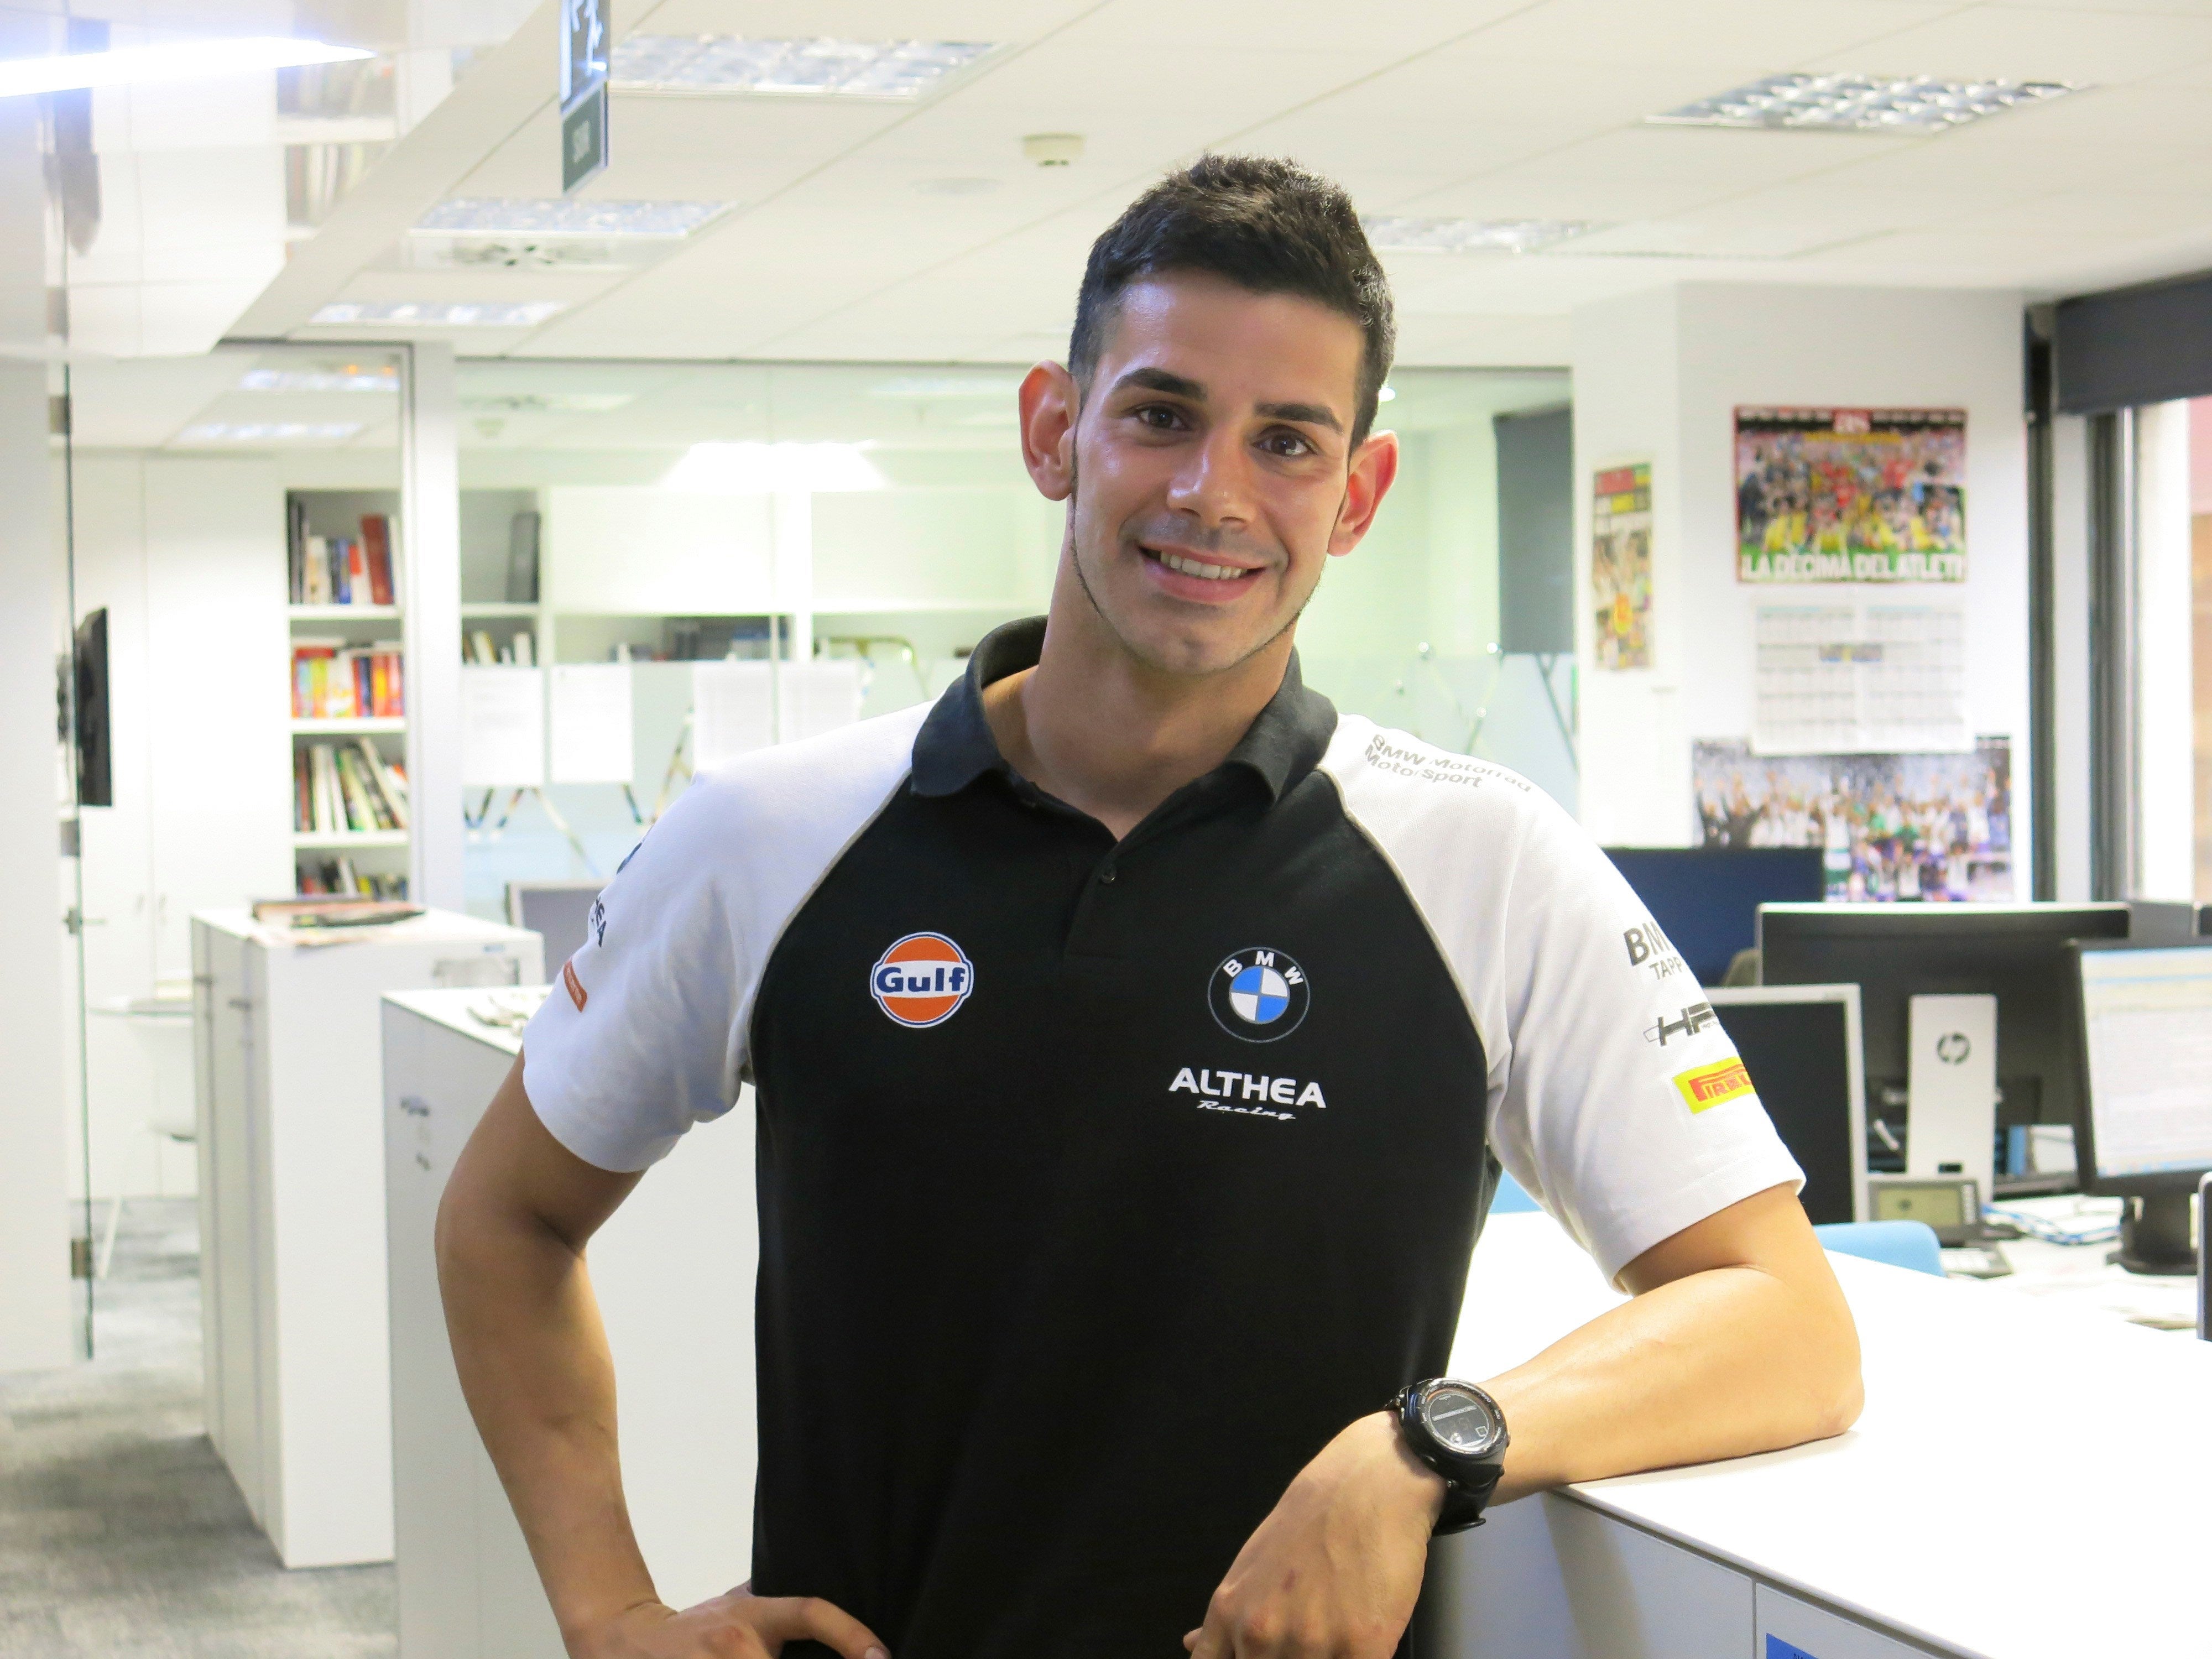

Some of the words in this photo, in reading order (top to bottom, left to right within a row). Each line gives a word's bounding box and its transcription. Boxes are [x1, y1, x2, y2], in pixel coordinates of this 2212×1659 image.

[1742, 554, 1771, 578] LA
[1372, 734, 1426, 765] BMW
[877, 967, 966, 993] Gulf
[1223, 951, 1303, 985] BMW
[1168, 1067, 1327, 1108] ALTHEA
[1197, 1100, 1296, 1120] Racing
